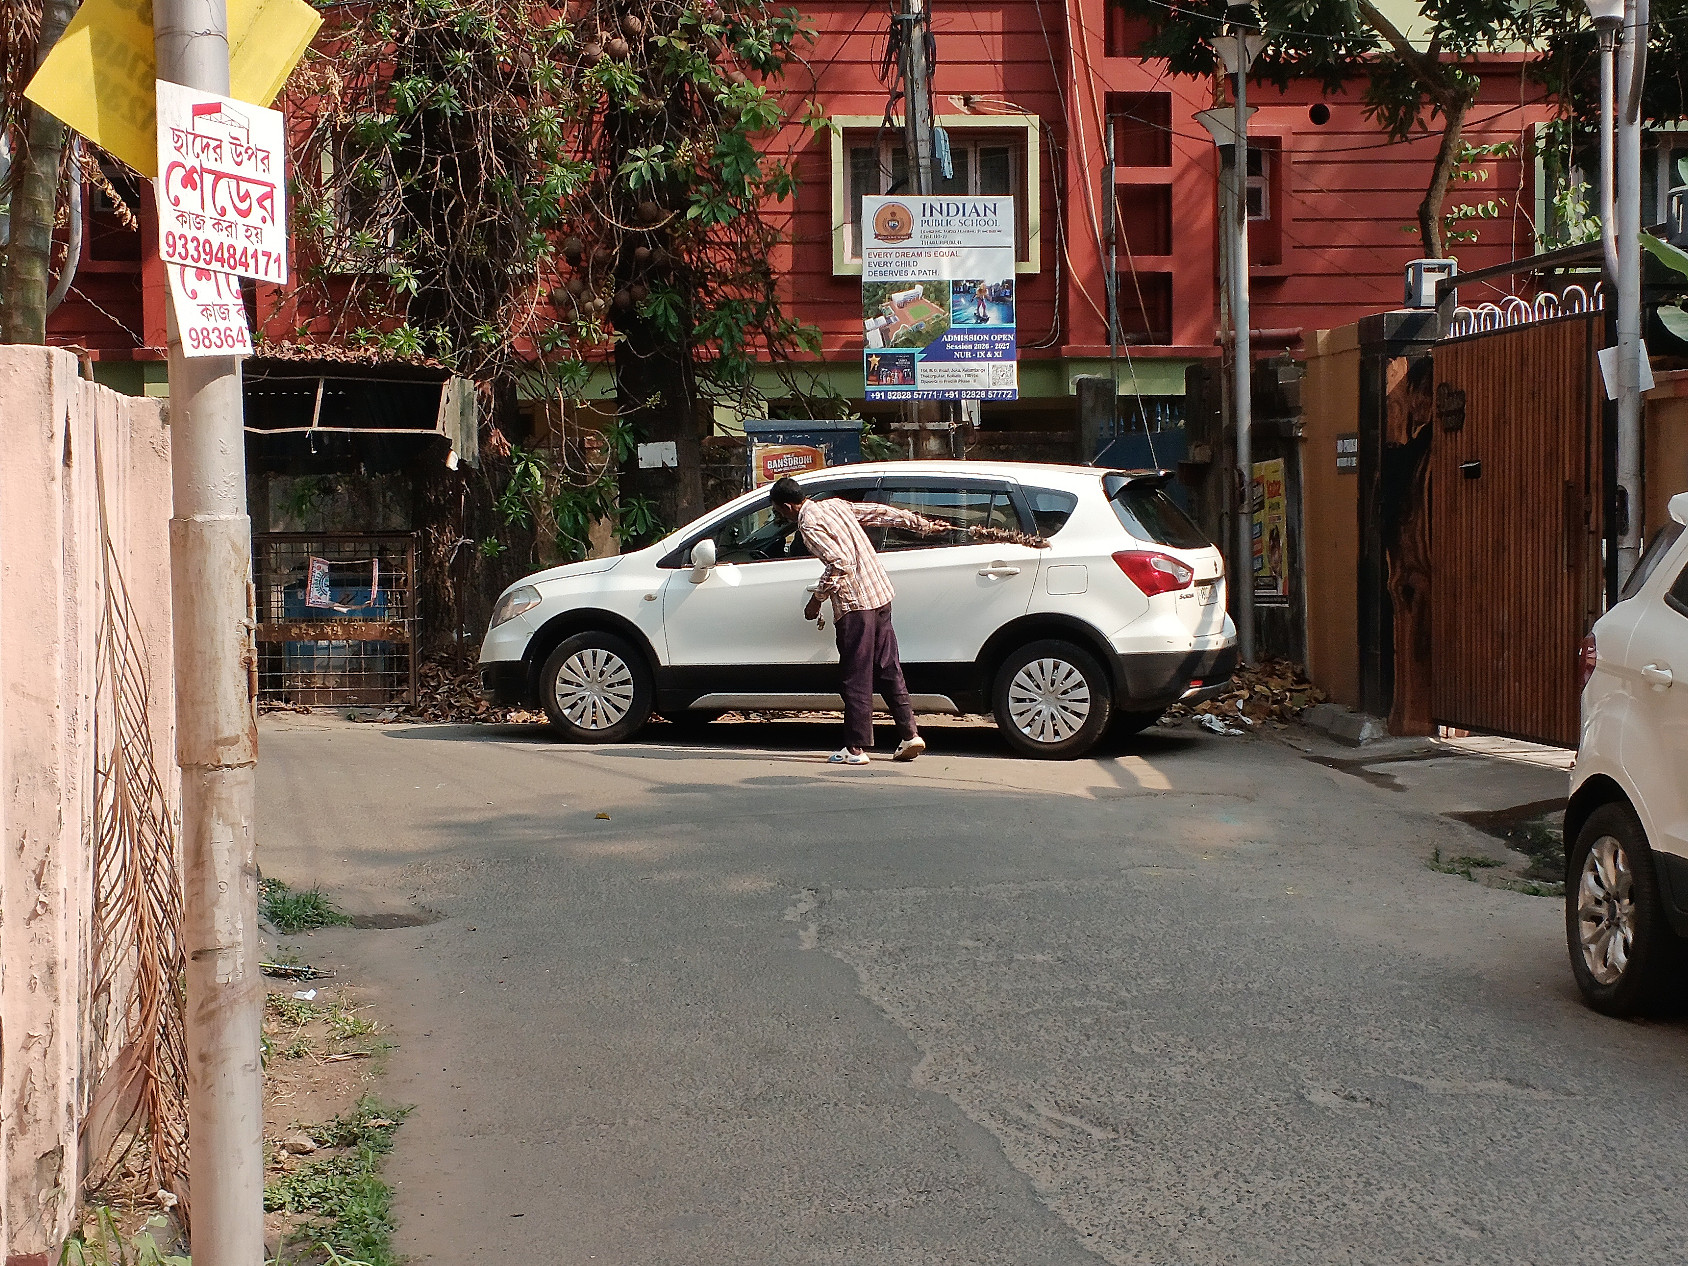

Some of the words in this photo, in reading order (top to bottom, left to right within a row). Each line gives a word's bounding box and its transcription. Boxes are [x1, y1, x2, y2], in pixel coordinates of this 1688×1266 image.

[169, 127, 223, 164] ছাদের
[228, 131, 271, 174] উপর
[165, 159, 277, 226] শেডের
[921, 202, 998, 217] INDIAN
[173, 208, 206, 233] কাজ
[209, 216, 238, 240] করা
[920, 219, 956, 228] PUBLIC
[959, 219, 1000, 227] SCHOOL
[165, 231, 282, 279] 9339484171
[196, 301, 230, 323] কাজ
[941, 334, 990, 342] ADMISSION
[954, 351, 972, 359] NUR
[870, 391, 885, 400] +91
[913, 391, 937, 399] 57771
[944, 391, 959, 399] +91
[988, 390, 1013, 398] 57772
